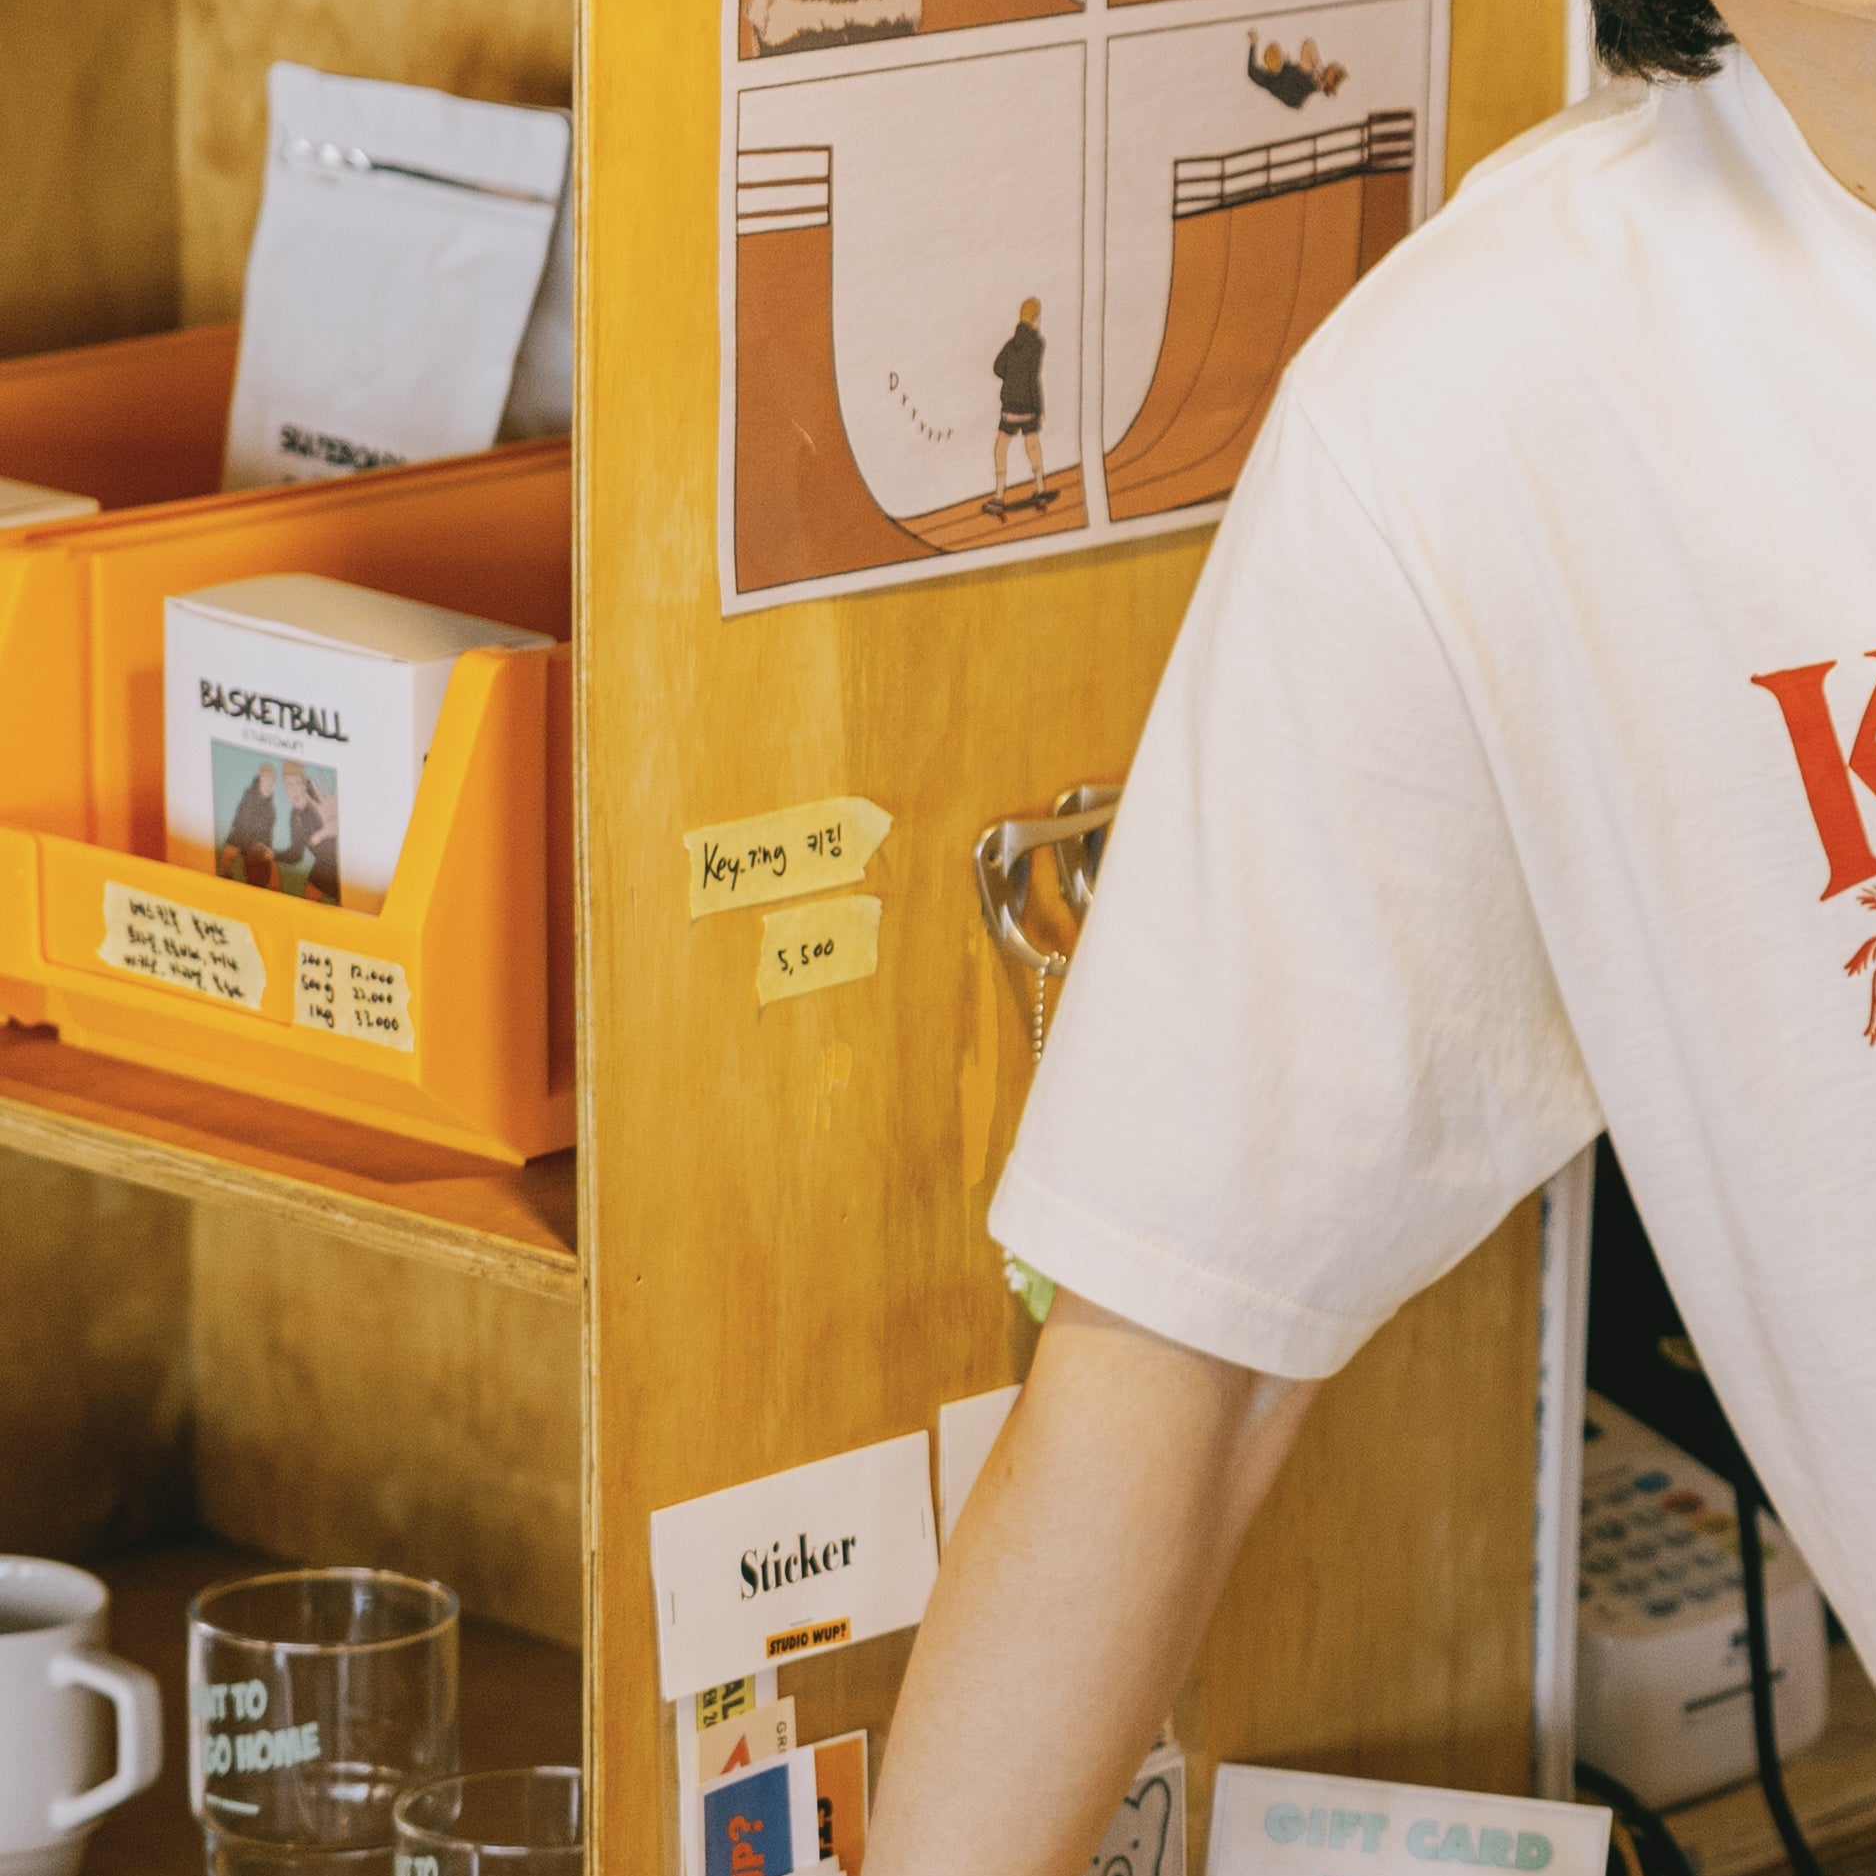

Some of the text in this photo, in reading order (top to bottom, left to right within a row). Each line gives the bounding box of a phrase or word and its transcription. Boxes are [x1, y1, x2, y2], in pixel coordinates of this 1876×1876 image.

[199, 676, 350, 742] BASKETBALL
[739, 1531, 858, 1602] Sticker
[768, 1623, 848, 1657] STUDIO WUP?
[235, 1720, 321, 1774] HOME
[1263, 1801, 1555, 1873] GIFT CARD
